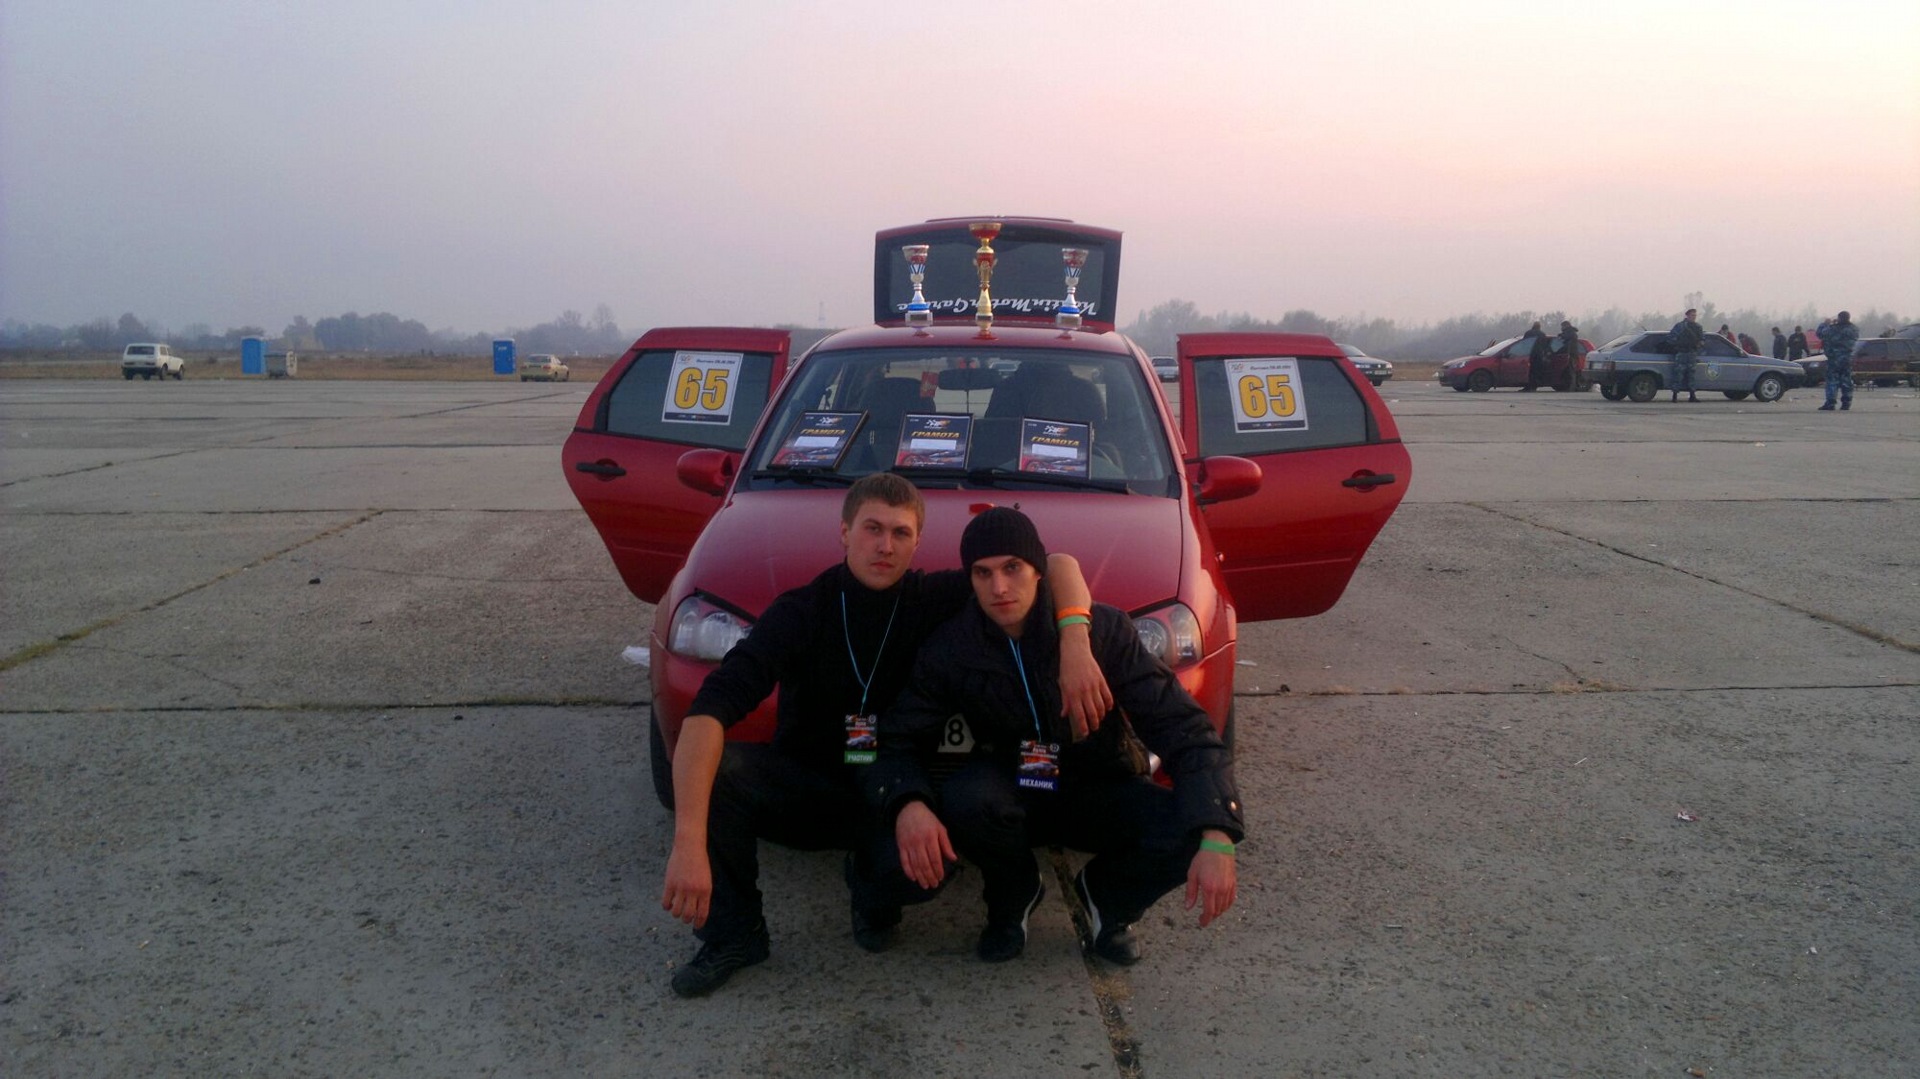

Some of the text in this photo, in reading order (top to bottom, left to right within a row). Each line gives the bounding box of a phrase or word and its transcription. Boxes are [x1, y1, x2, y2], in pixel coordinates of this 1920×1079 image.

[674, 367, 730, 411] 65
[1238, 374, 1297, 418] 65
[1031, 436, 1080, 446] ГРАМОТА
[1019, 778, 1054, 790] МЕХАНИК
